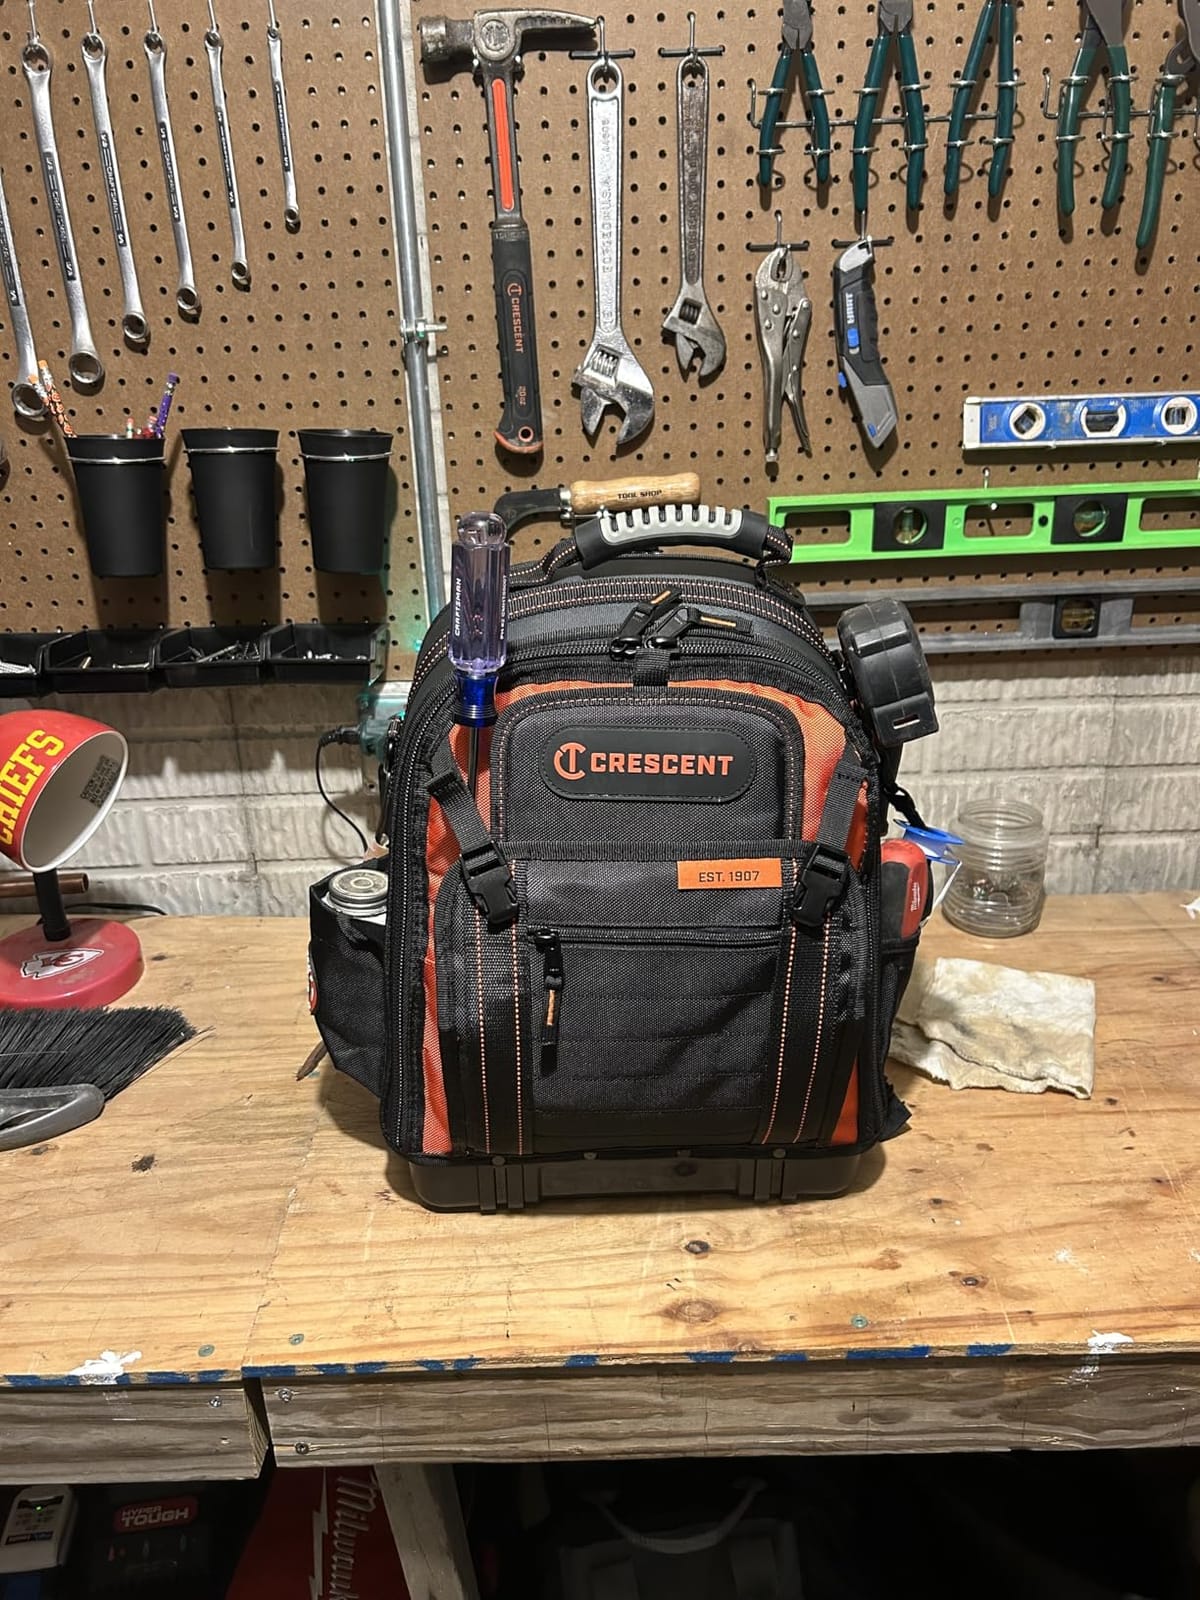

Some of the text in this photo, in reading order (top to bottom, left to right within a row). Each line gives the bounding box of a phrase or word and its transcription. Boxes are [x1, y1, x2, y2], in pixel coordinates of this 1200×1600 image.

[106, 165, 119, 214] CRAFTSMAN
[845, 292, 855, 324] HART
[511, 297, 524, 353] CRESCENT
[617, 488, 662, 500] TOOL SHOP
[454, 577, 462, 637] CRAFTSMAN
[590, 752, 735, 776] CRESCENT
[698, 870, 760, 883] EST. 1907
[121, 1505, 162, 1518] HYPER
[121, 1507, 189, 1528] TOUGH
